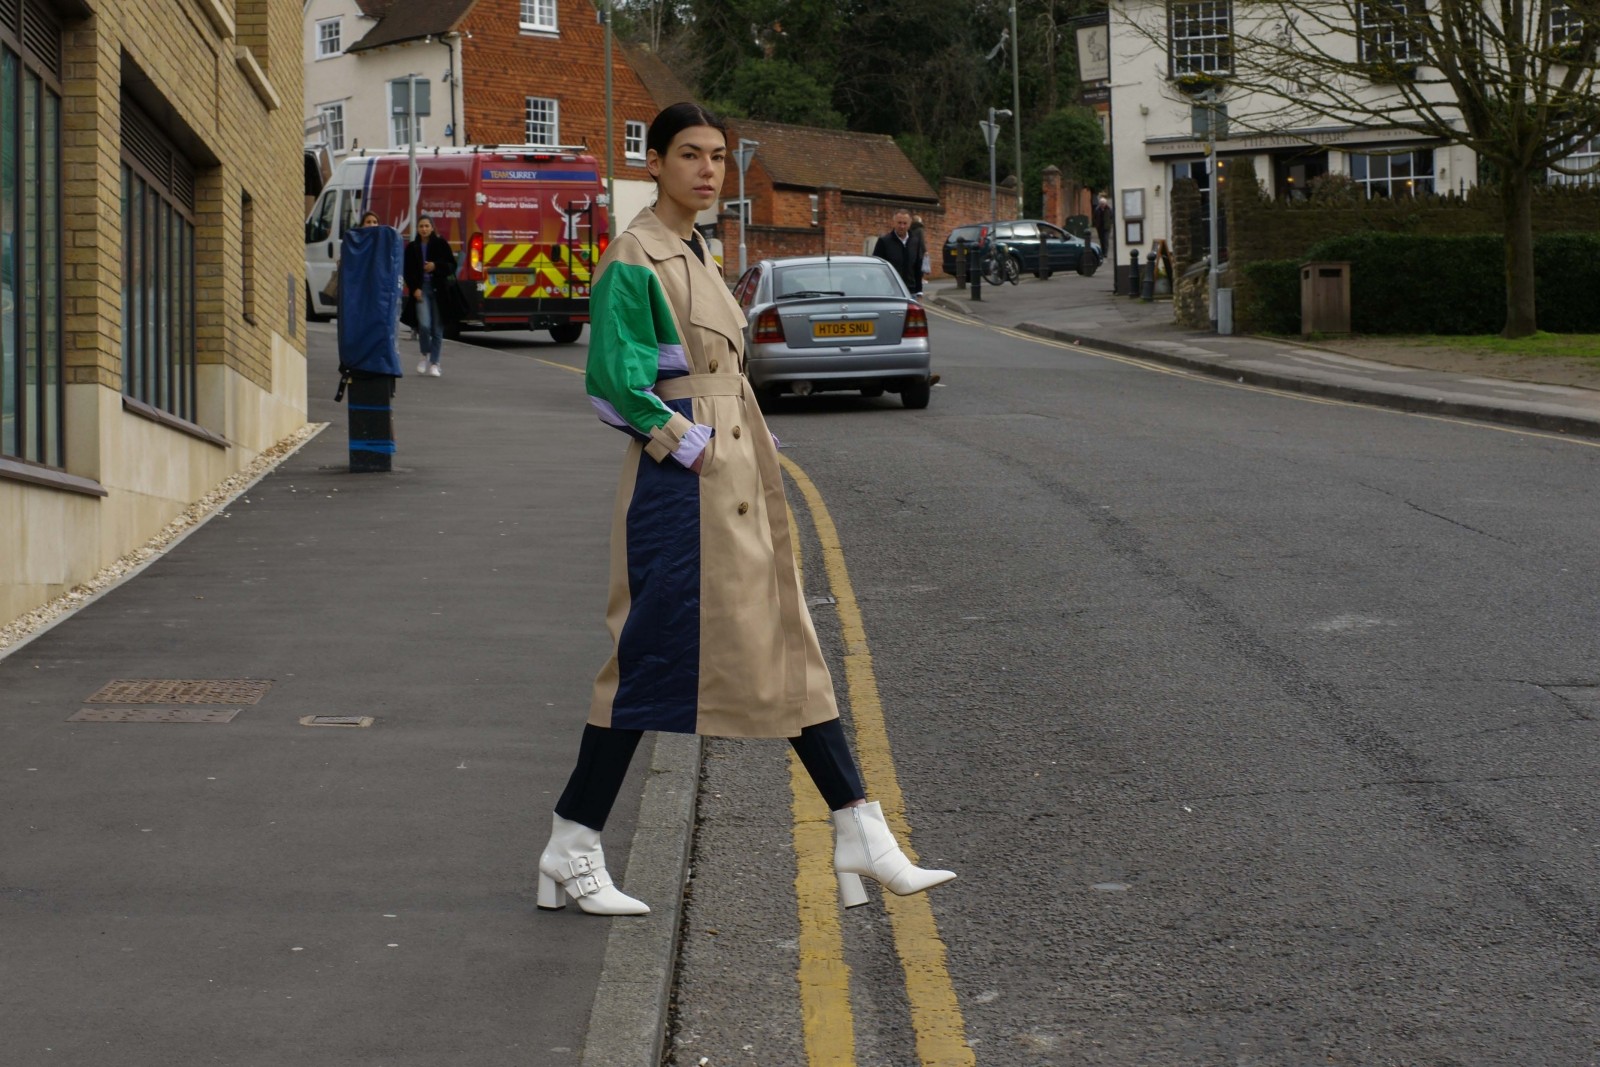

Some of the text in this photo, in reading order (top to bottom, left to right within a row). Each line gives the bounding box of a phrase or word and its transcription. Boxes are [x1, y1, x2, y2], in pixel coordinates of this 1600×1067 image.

[1241, 136, 1266, 147] THE
[819, 323, 869, 334] HT05 SNU
